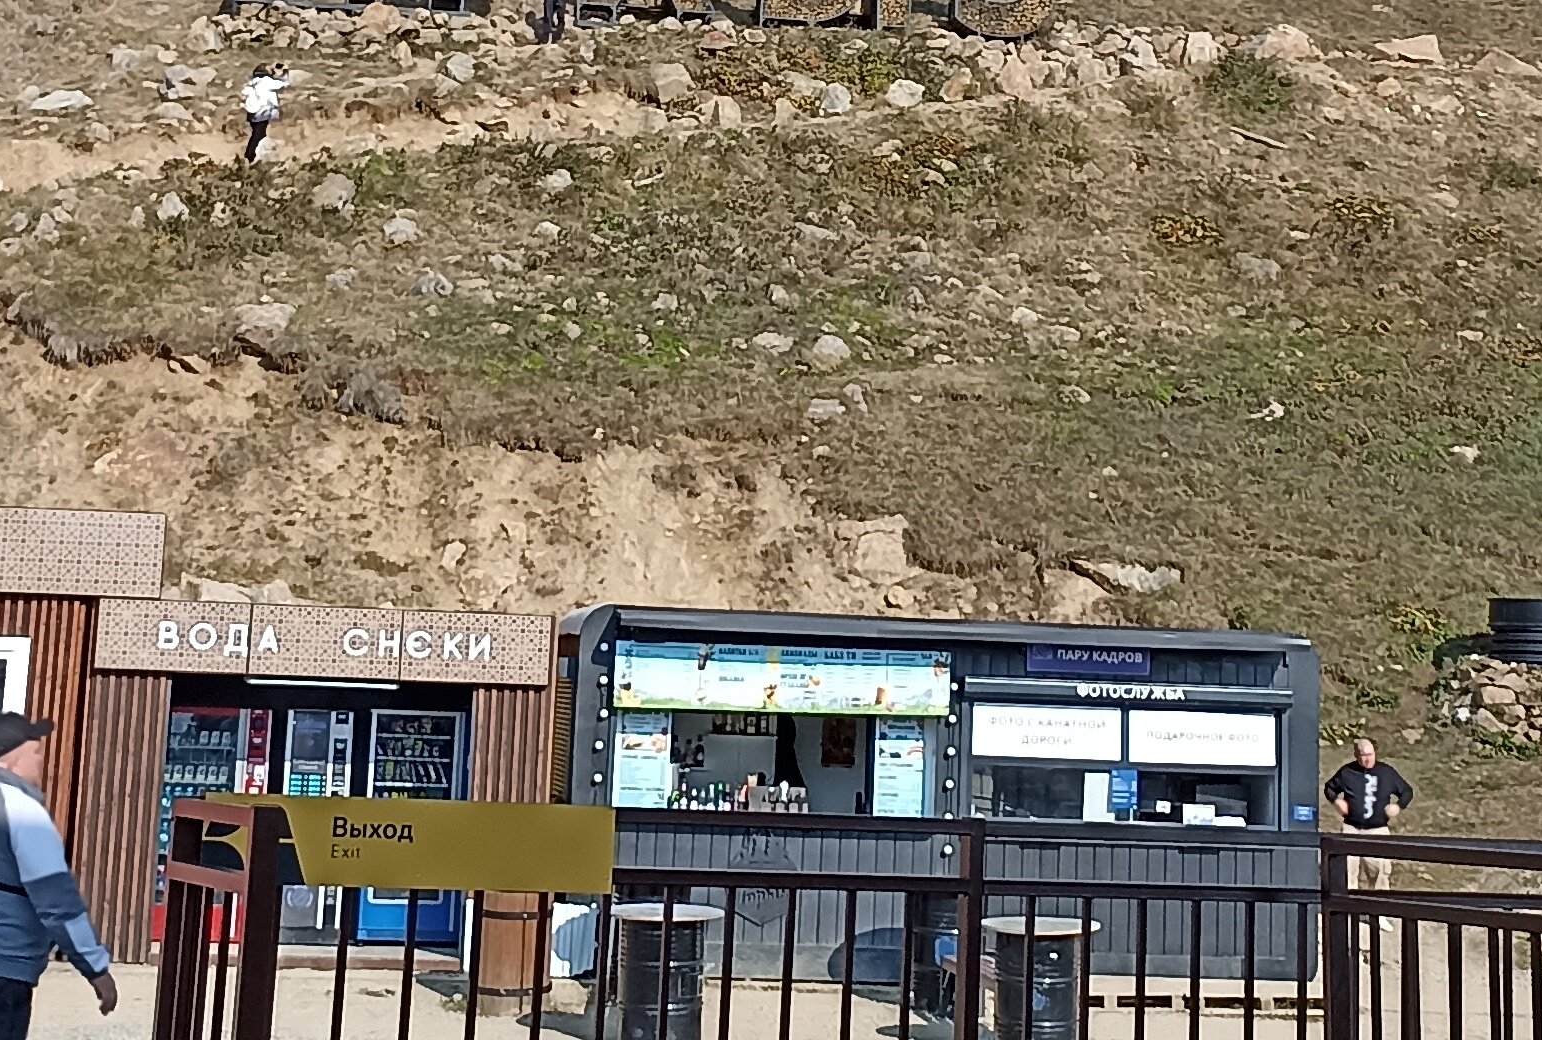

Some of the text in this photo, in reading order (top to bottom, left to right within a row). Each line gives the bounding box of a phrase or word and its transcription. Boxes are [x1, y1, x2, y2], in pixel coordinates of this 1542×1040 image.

[156, 619, 279, 658] ВОДА
[1056, 647, 1144, 665] ПАРУ КАДРОВ
[1075, 682, 1186, 701] ФОТОСЛУЖБА
[332, 815, 414, 844] Выход
[330, 843, 362, 859] Exit
